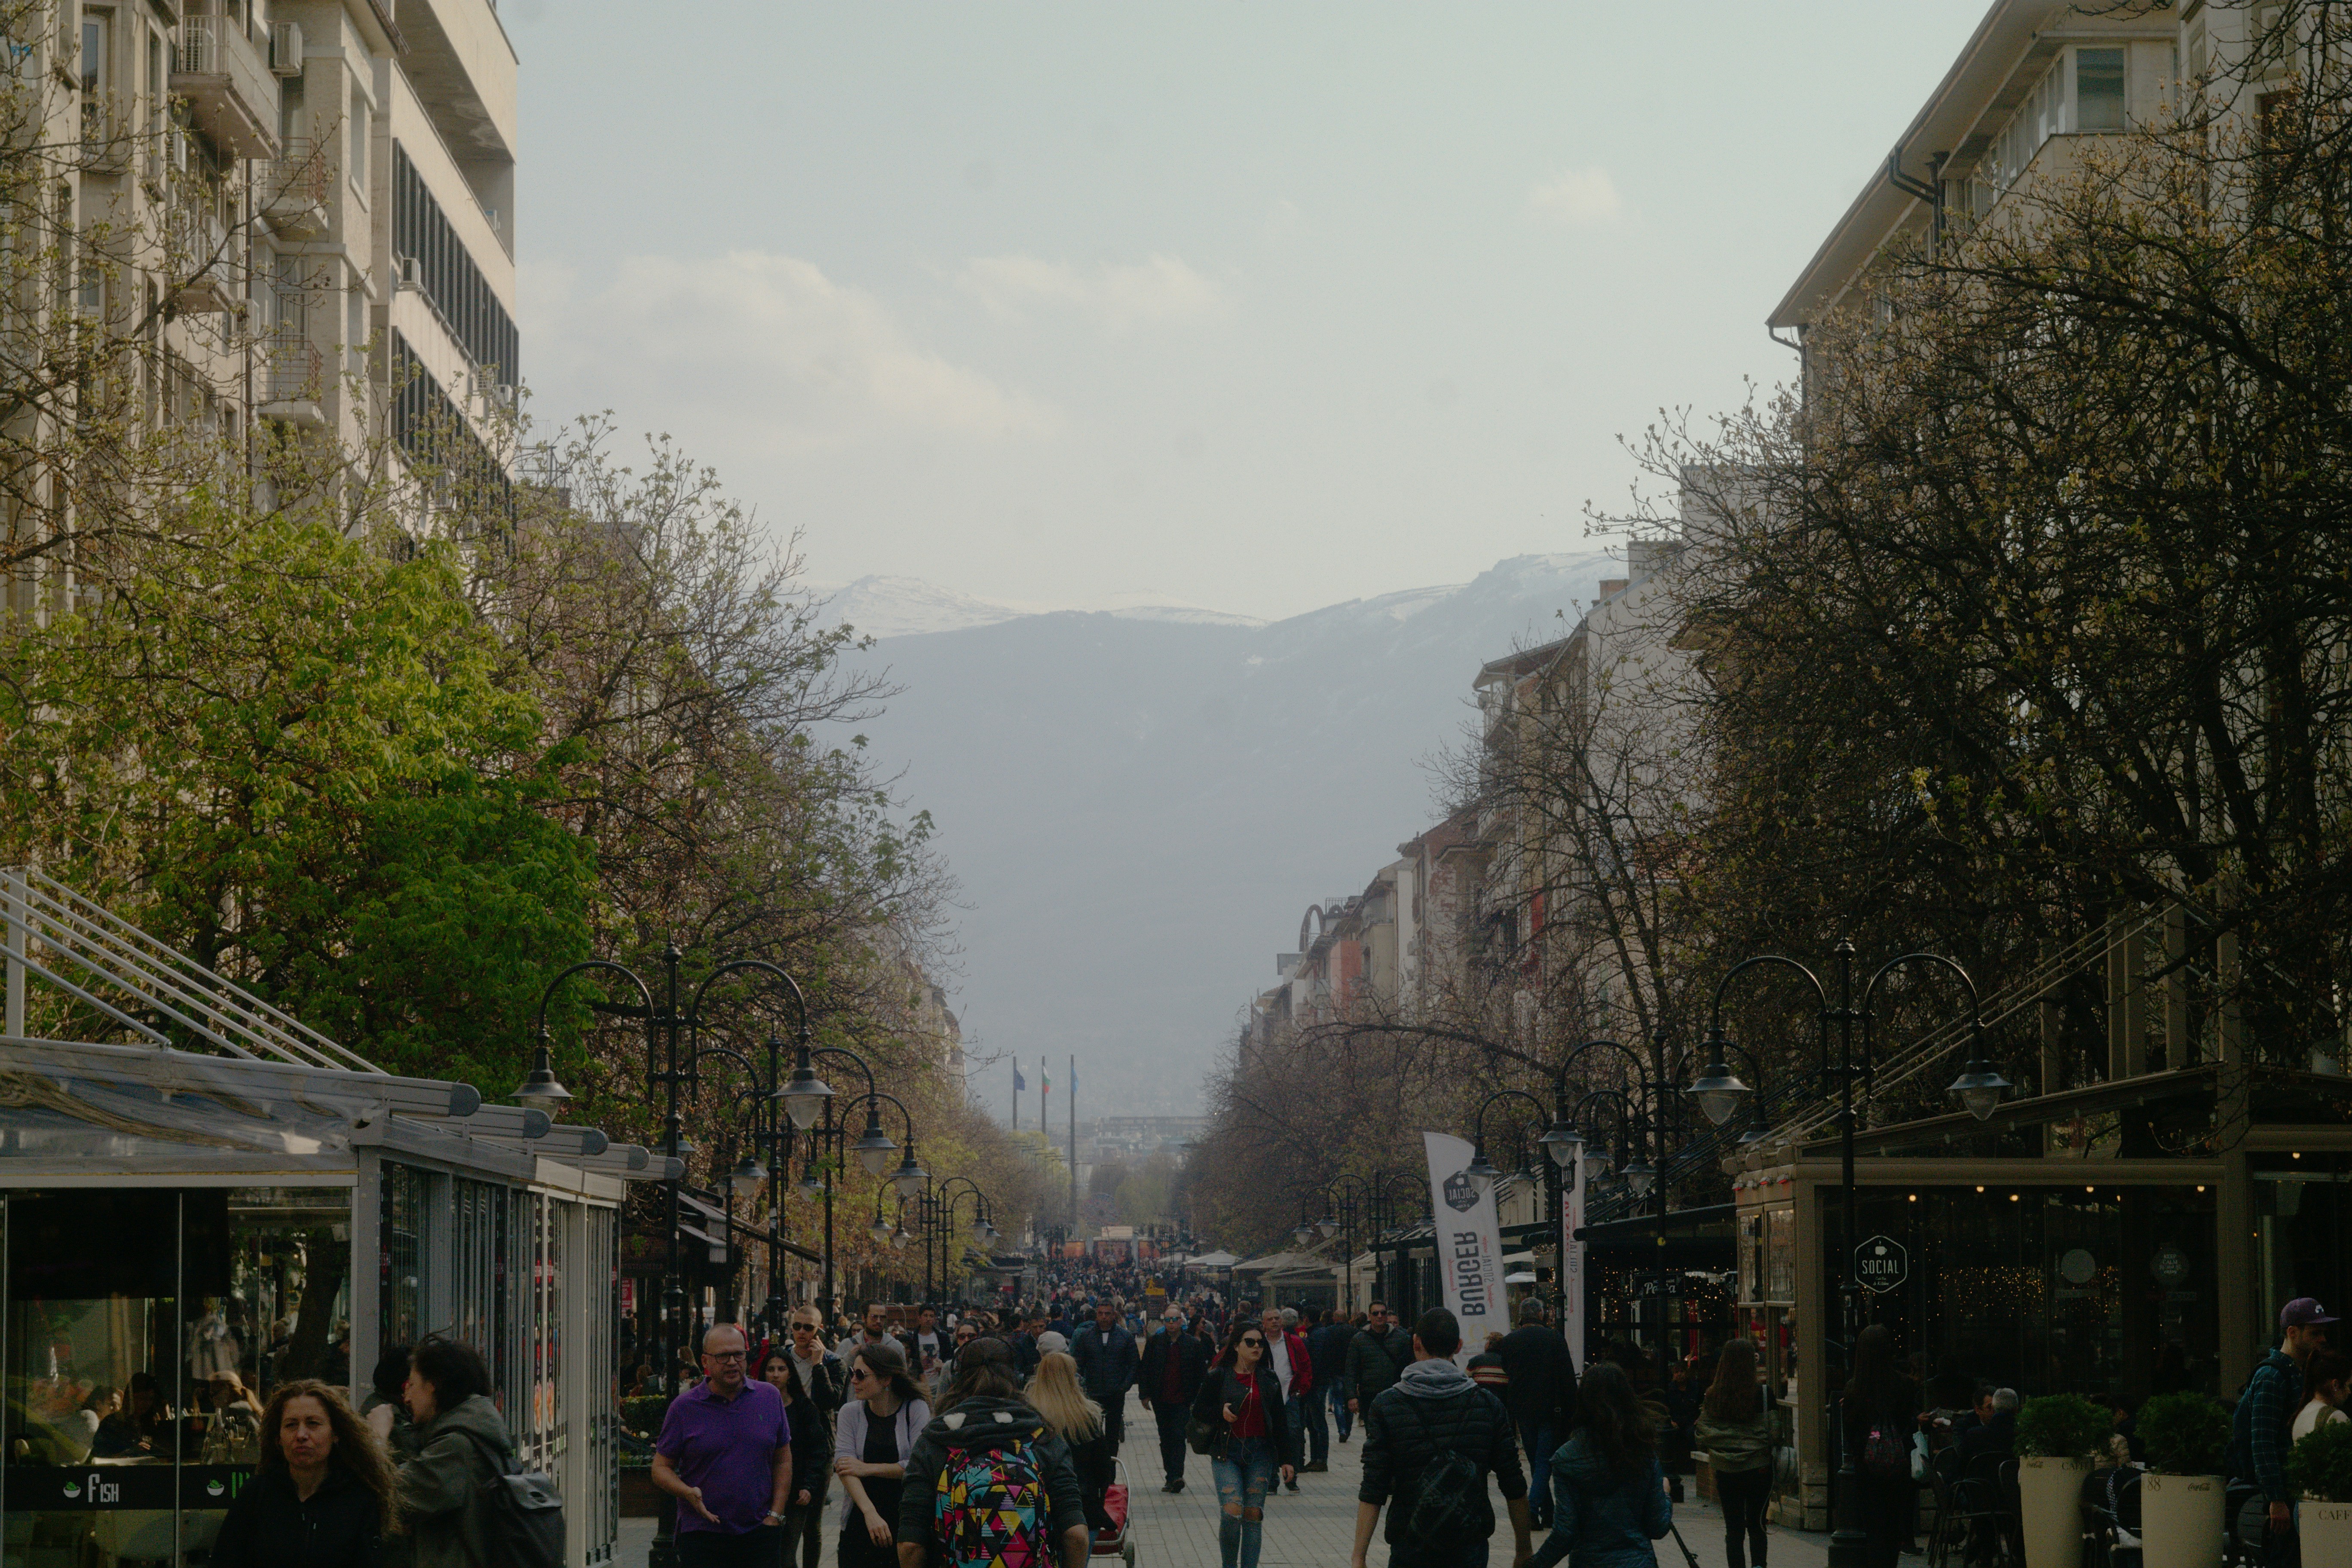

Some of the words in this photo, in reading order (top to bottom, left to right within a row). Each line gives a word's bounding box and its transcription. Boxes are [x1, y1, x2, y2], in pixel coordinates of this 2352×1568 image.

[1862, 1259, 1899, 1274] SOCIAL
[1644, 1282, 1677, 1295] Paa
[2147, 1476, 2161, 1491] 88
